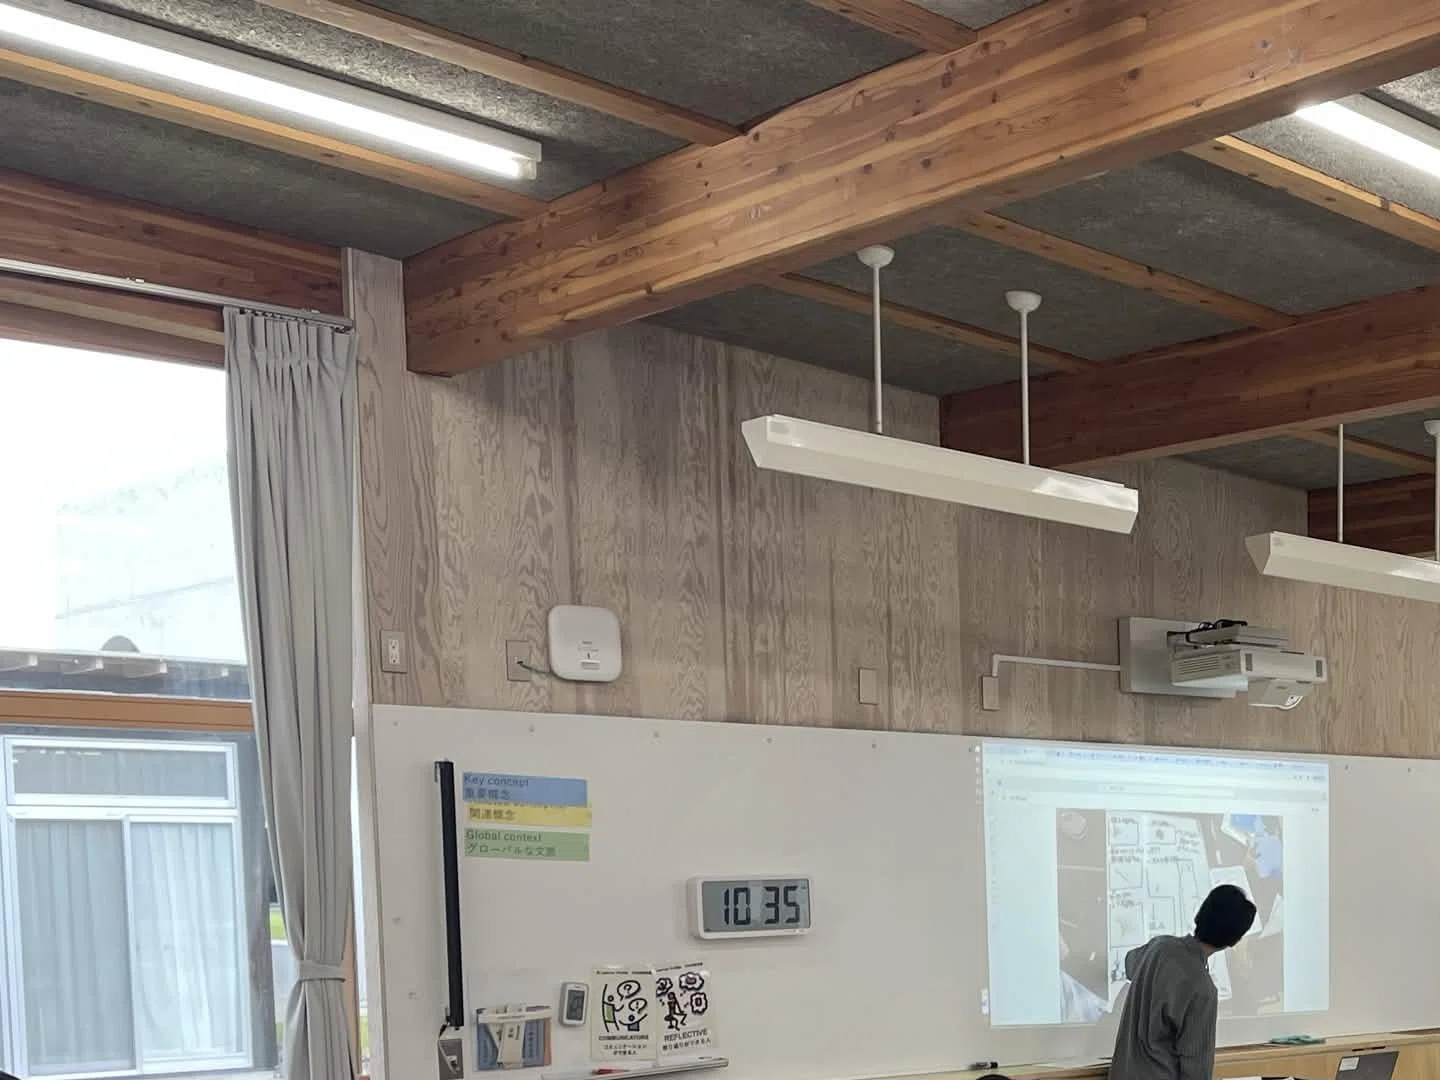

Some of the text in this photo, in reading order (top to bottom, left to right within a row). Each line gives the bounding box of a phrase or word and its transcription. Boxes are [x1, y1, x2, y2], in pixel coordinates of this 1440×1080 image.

[463, 775, 530, 787] Key concept
[466, 829, 542, 842] Global context
[664, 1028, 708, 1043] REFLECTIVE
